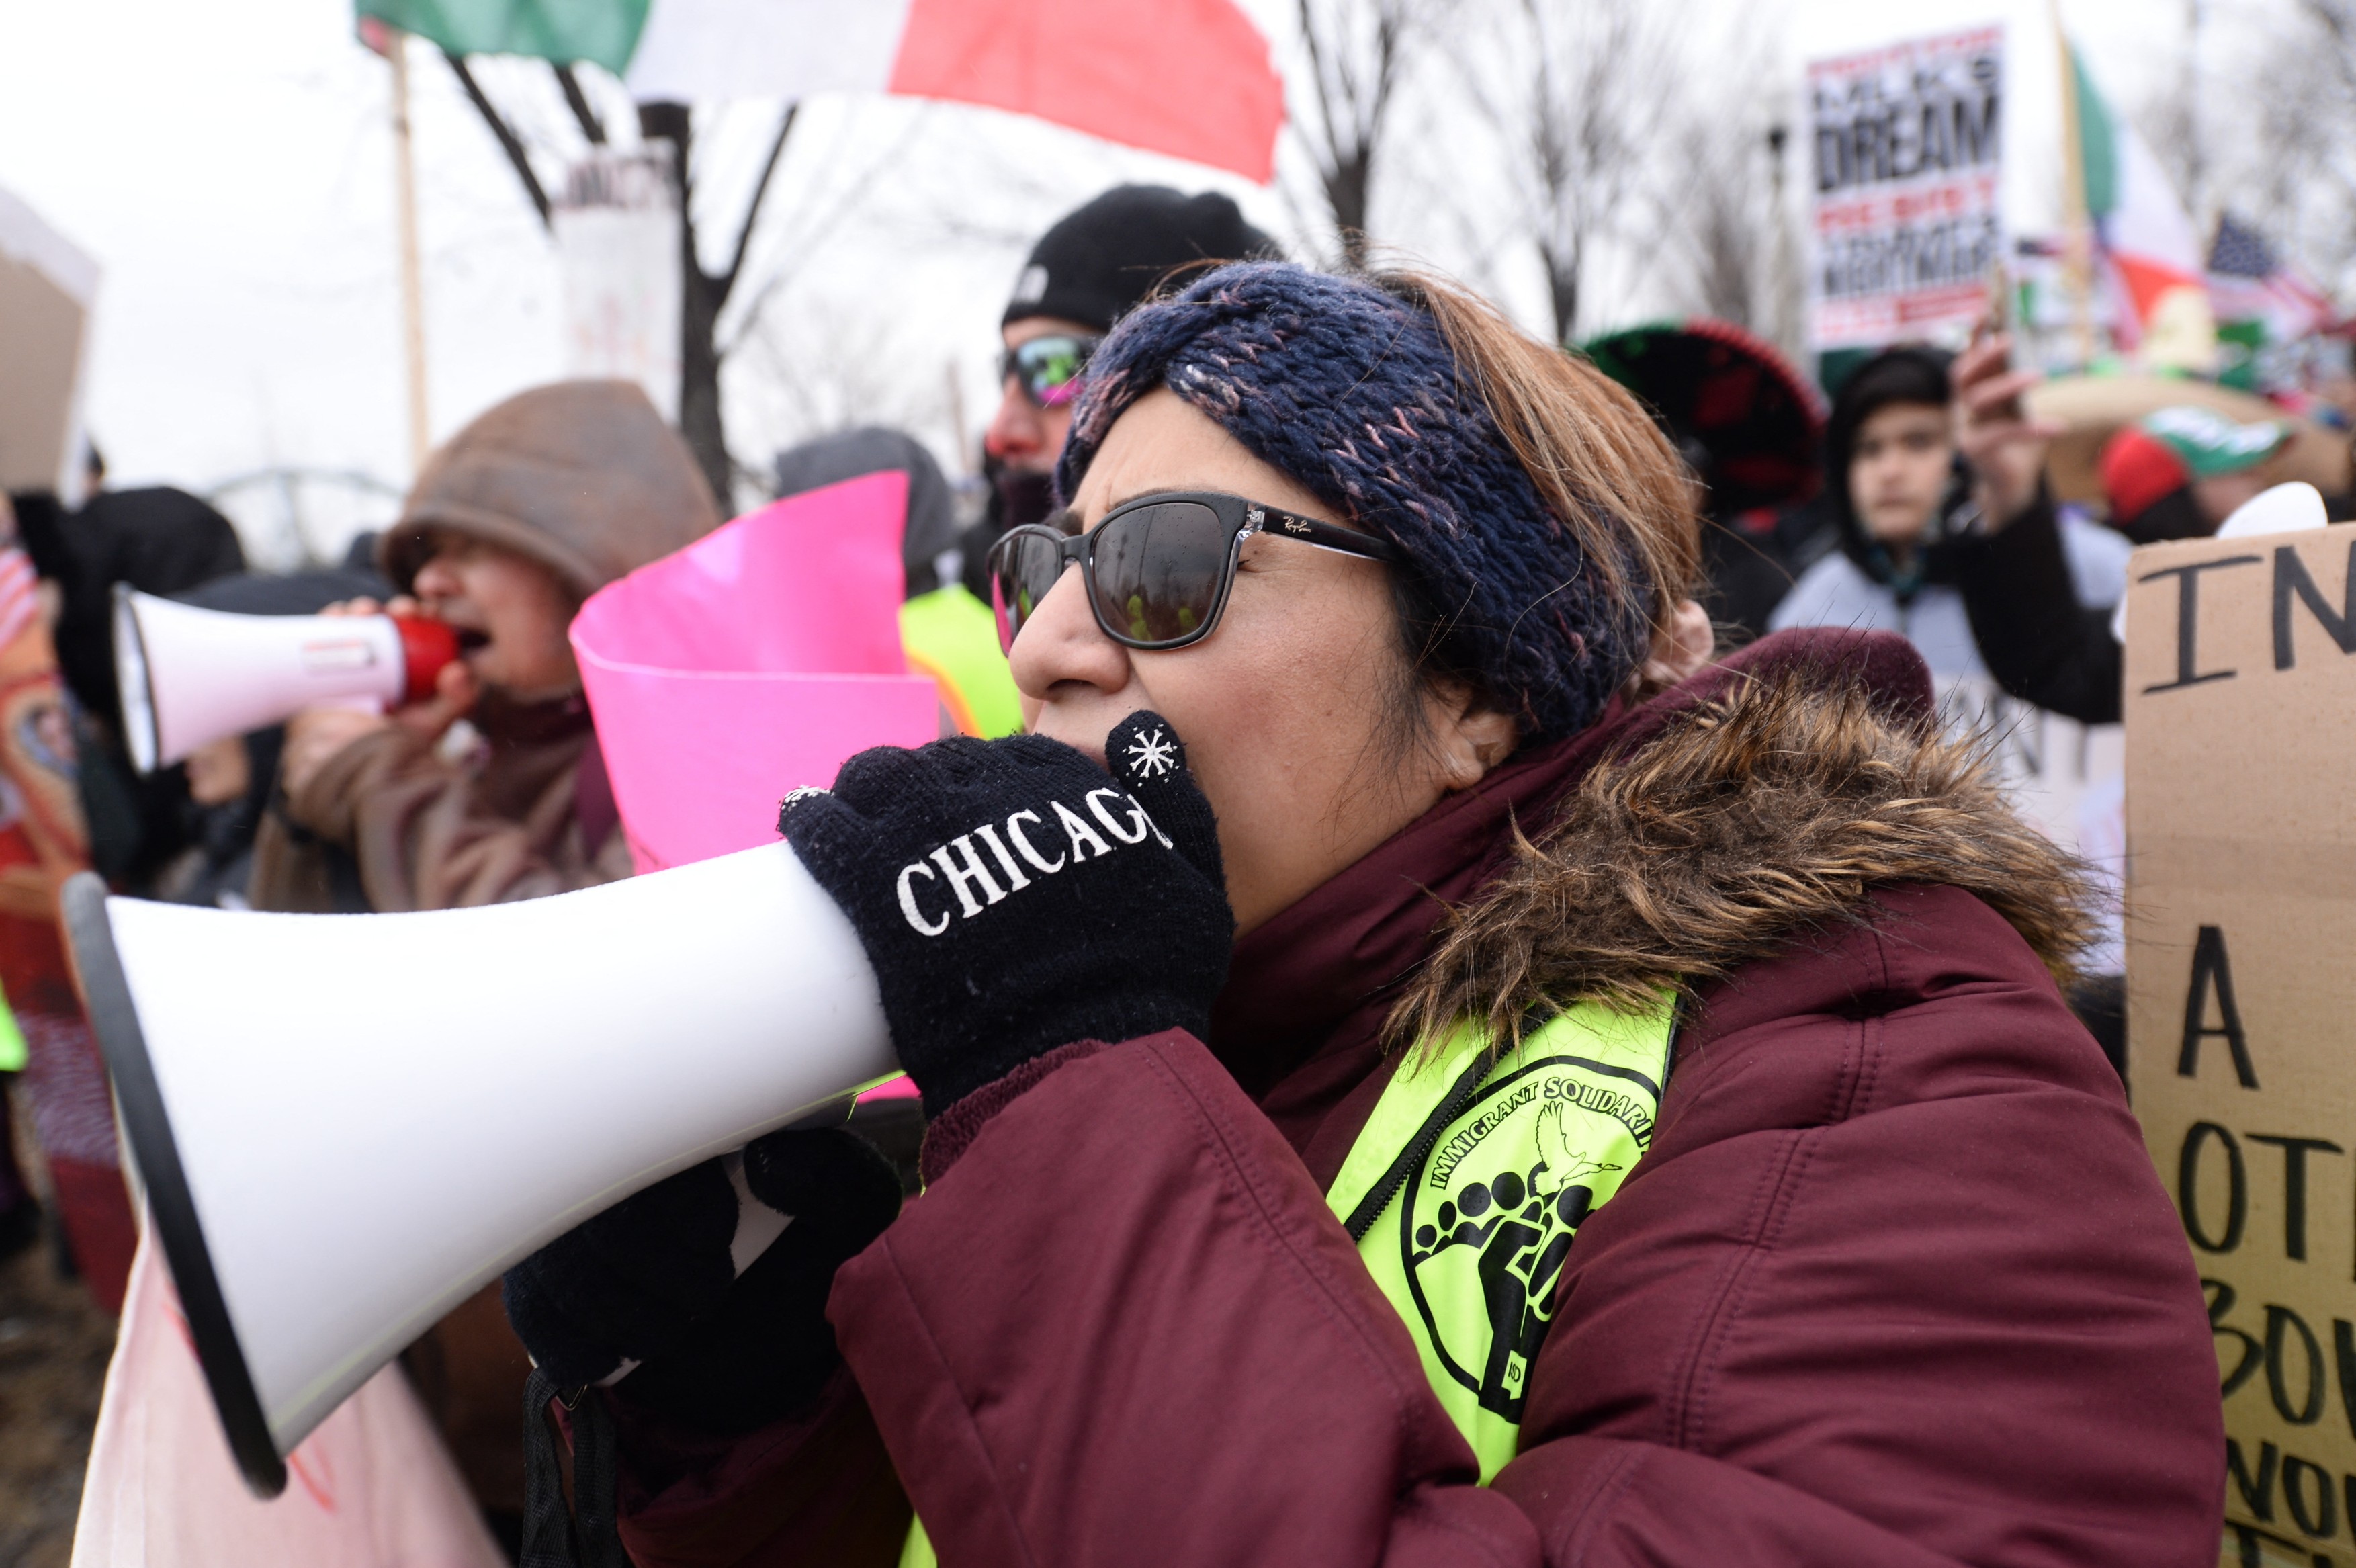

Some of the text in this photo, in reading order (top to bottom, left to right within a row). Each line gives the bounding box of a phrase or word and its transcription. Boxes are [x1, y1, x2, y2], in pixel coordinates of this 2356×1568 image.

[1815, 91, 2001, 192] DREAM
[896, 787, 1174, 937] CHICAG
[2177, 923, 2261, 1091] A
[1430, 1076, 1654, 1190] IMMIGRANT SOLIDARI
[2179, 1121, 2356, 1282] OT
